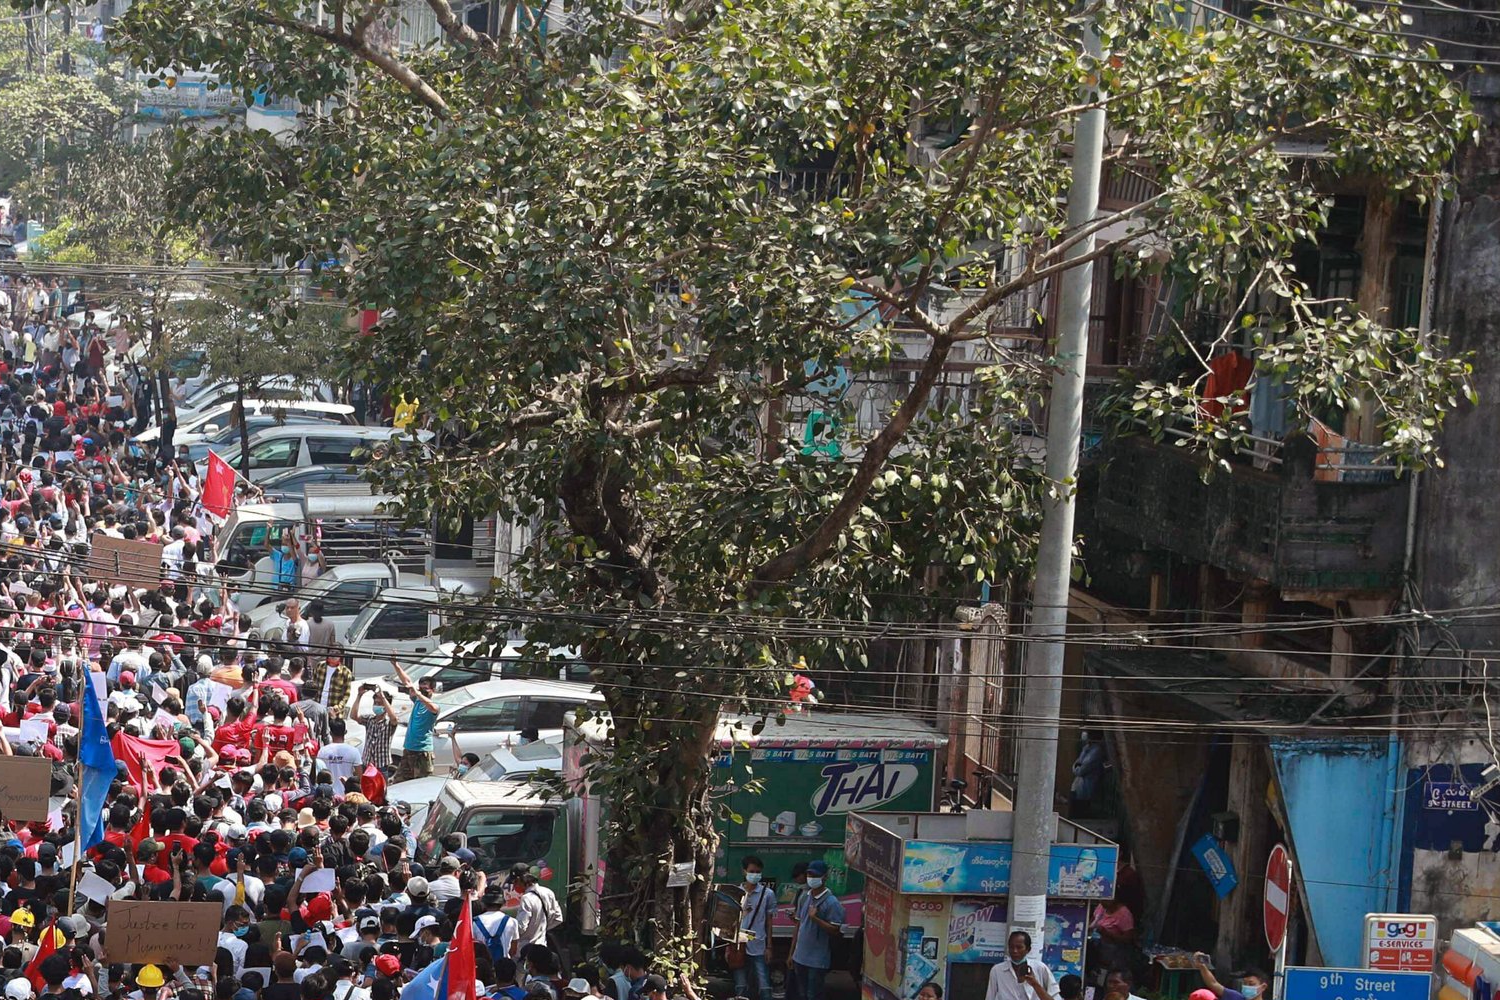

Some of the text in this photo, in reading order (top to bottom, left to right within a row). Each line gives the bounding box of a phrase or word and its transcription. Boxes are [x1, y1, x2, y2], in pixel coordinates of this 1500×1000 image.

[772, 750, 792, 758] BATT
[858, 751, 879, 759] BATT
[815, 763, 901, 816] THAI
[113, 904, 169, 931] Justice
[1379, 940, 1424, 948] E-SERVICES
[1319, 972, 1396, 993] 9th Street
